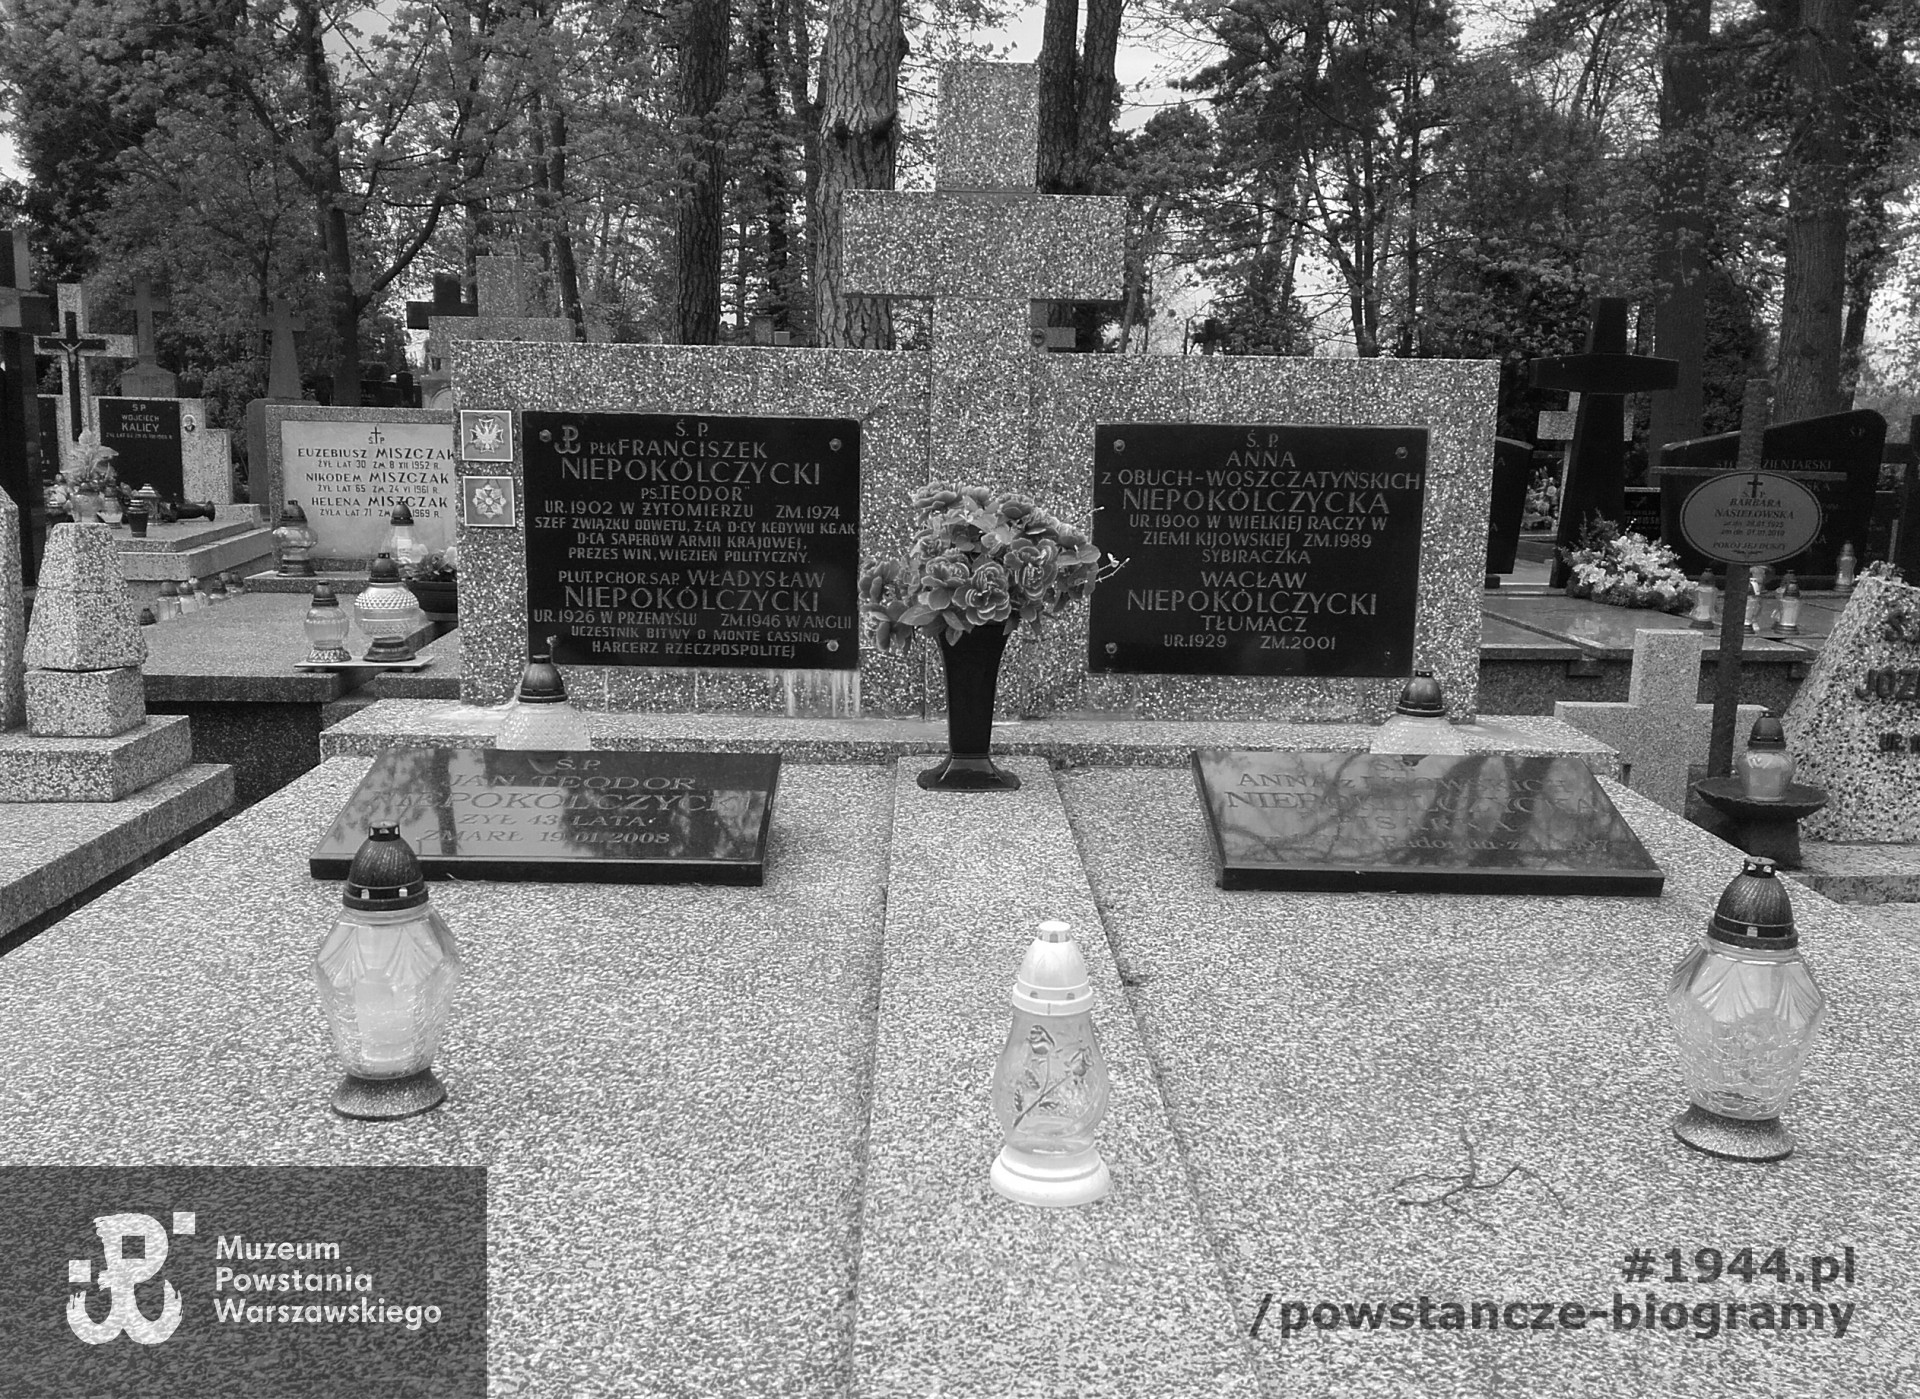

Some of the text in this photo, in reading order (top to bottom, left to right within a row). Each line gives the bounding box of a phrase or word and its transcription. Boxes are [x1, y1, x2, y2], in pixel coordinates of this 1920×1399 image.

[121, 414, 160, 422] WOJCIECH
[121, 422, 160, 433] KALICY
[297, 447, 454, 460] EUZEBIUSZ MISZCZAK
[618, 438, 768, 459] FRANCISZEK
[356, 460, 366, 468] 30
[389, 461, 395, 469] 8
[412, 461, 430, 470] 1952
[1226, 450, 1296, 468] ANNA
[306, 472, 449, 484] NIKODEM MISZCZAK
[561, 456, 820, 485] NIEPOKÓLCZYCKI
[336, 485, 351, 493] LAT
[355, 484, 366, 493] 65
[389, 485, 399, 493] 24
[414, 485, 429, 494] 1961
[312, 496, 447, 508] HELENA MISZCZAK
[1123, 487, 1390, 514] NIEPOKÓLCZYCKA
[1729, 498, 1782, 508] BARBARA
[345, 509, 360, 517] LAT
[364, 508, 372, 516] 71
[413, 509, 430, 518] 1969
[620, 502, 635, 515] W
[535, 516, 566, 529] SZEF
[572, 517, 630, 531] ZWIĄZKU
[762, 522, 815, 534] KEDYWU
[1207, 515, 1221, 529] W
[1228, 515, 1302, 533] WIELKIEJ
[1307, 516, 1366, 531] RACZY
[1371, 516, 1388, 531] W
[678, 534, 721, 547] ARMII
[1142, 531, 1190, 546] ZIEMI
[1195, 532, 1291, 550] KIJOWSKIEJ
[568, 547, 618, 560] PREZES
[1201, 549, 1311, 564] SYBIRACZKA
[686, 569, 826, 588] WŁADYSŁAW
[1200, 570, 1307, 589] WACŁAW
[565, 585, 819, 612] NIEPOKÓLCZYCKI
[1127, 588, 1377, 616] NIEPOKÓLCZYCKI
[600, 611, 613, 624] W
[618, 610, 697, 626] PRZEMYŚLU
[785, 615, 800, 628] W
[803, 615, 851, 629] ANGLII
[1200, 614, 1307, 633] TŁUMACZ
[571, 625, 820, 643] UCZESTNIK BITWY O MONTE CASSINO
[592, 640, 659, 654] HARCERZ
[450, 773, 697, 791] JAN TEODOR
[1238, 773, 1328, 788] ANNA
[527, 814, 559, 826] 43
[572, 815, 646, 827] LATA
[420, 829, 524, 842] ZMARŁ
